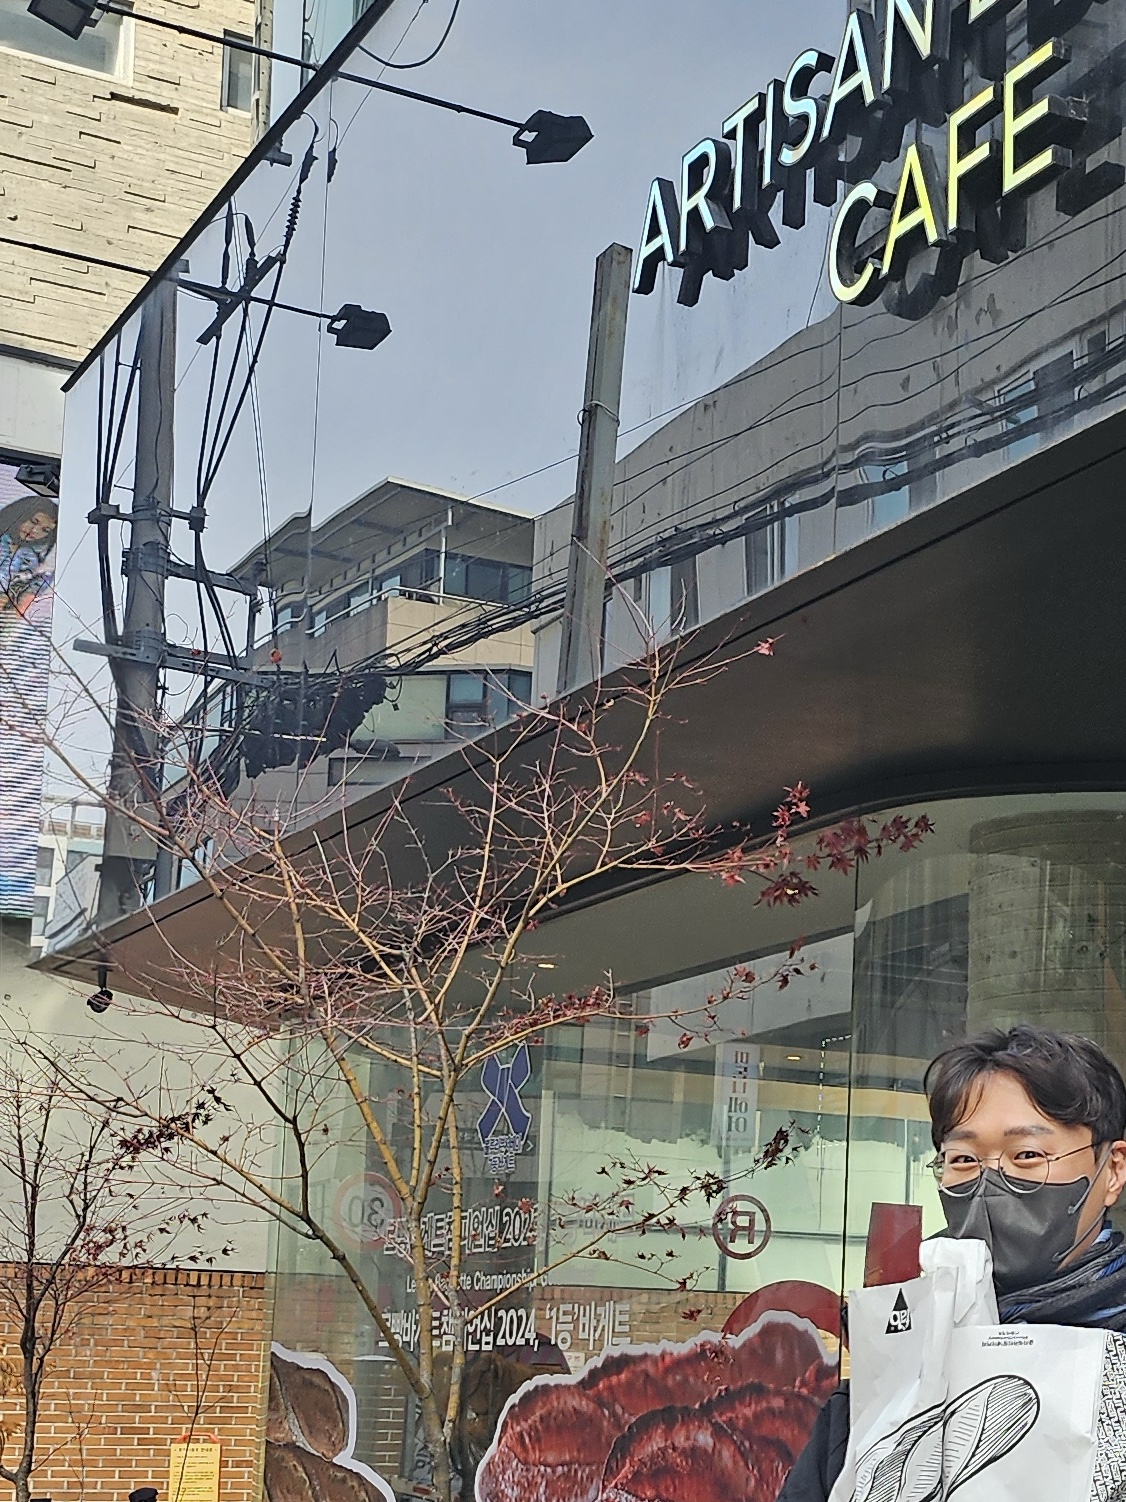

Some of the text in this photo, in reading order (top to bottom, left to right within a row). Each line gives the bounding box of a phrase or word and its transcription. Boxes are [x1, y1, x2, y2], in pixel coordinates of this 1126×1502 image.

[633, 0, 937, 293] ARTISAN
[828, 38, 1071, 304] CAFE
[496, 1308, 539, 1351] 2024,
